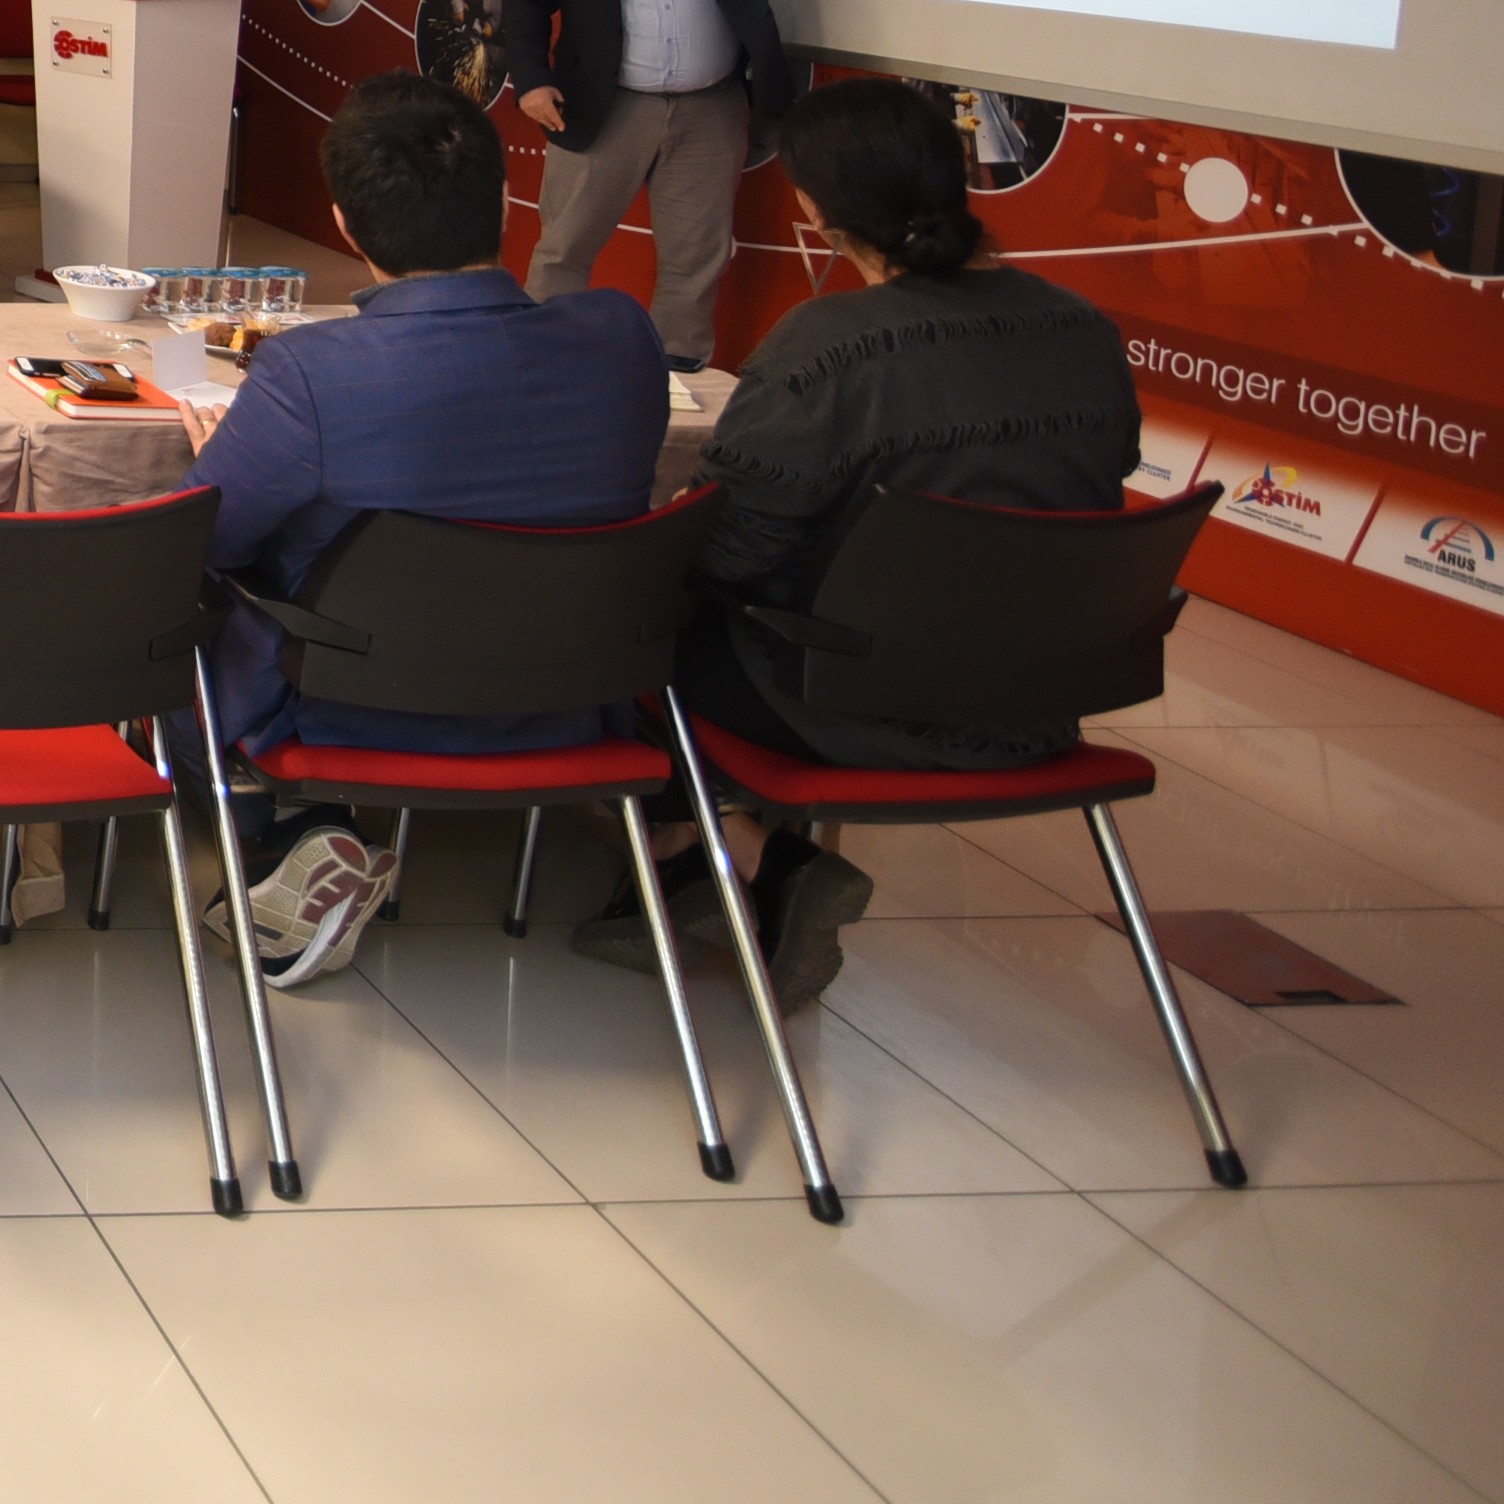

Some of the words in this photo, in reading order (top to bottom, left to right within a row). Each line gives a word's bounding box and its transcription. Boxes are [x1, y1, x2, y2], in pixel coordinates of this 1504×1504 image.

[1125, 337, 1287, 406] stronger
[1296, 376, 1488, 464] together
[1437, 549, 1476, 573] ARUS
